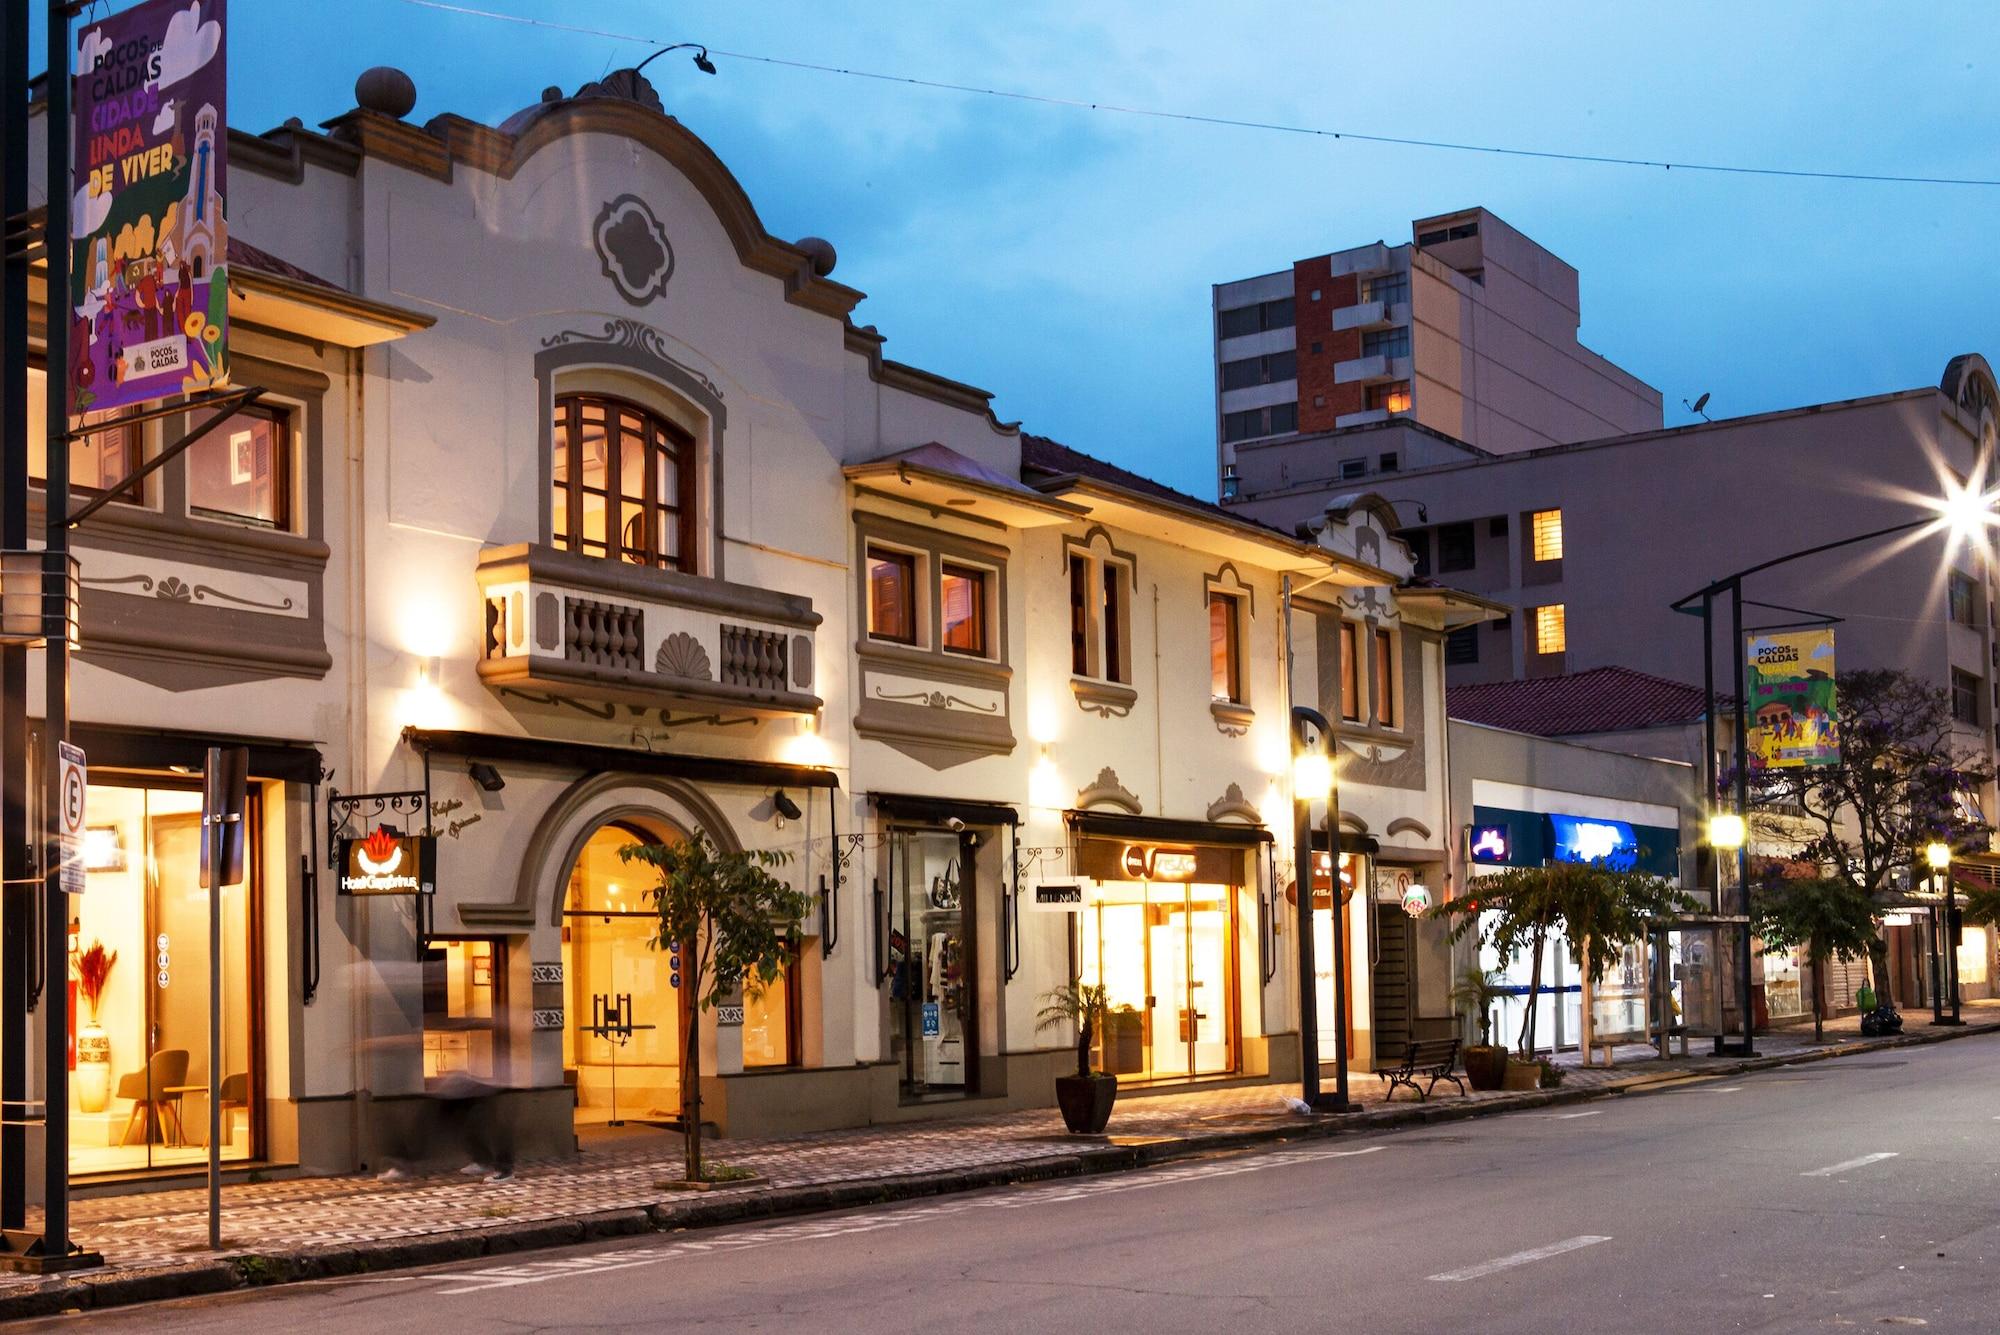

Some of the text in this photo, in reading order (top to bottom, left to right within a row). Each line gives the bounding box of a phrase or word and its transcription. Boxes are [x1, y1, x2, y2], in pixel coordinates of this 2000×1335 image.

[94, 35, 163, 76] POÇOS DE
[92, 55, 162, 102] CALDAS
[91, 82, 159, 133] CIDADE
[89, 122, 145, 166] LINDA
[88, 143, 174, 199] DE VIVER
[151, 346, 173, 358] POÇOS
[151, 355, 179, 369] CALDAS
[1758, 645, 1791, 656] POÇOS
[1758, 653, 1799, 664] CALDAS
[69, 779, 78, 818] E
